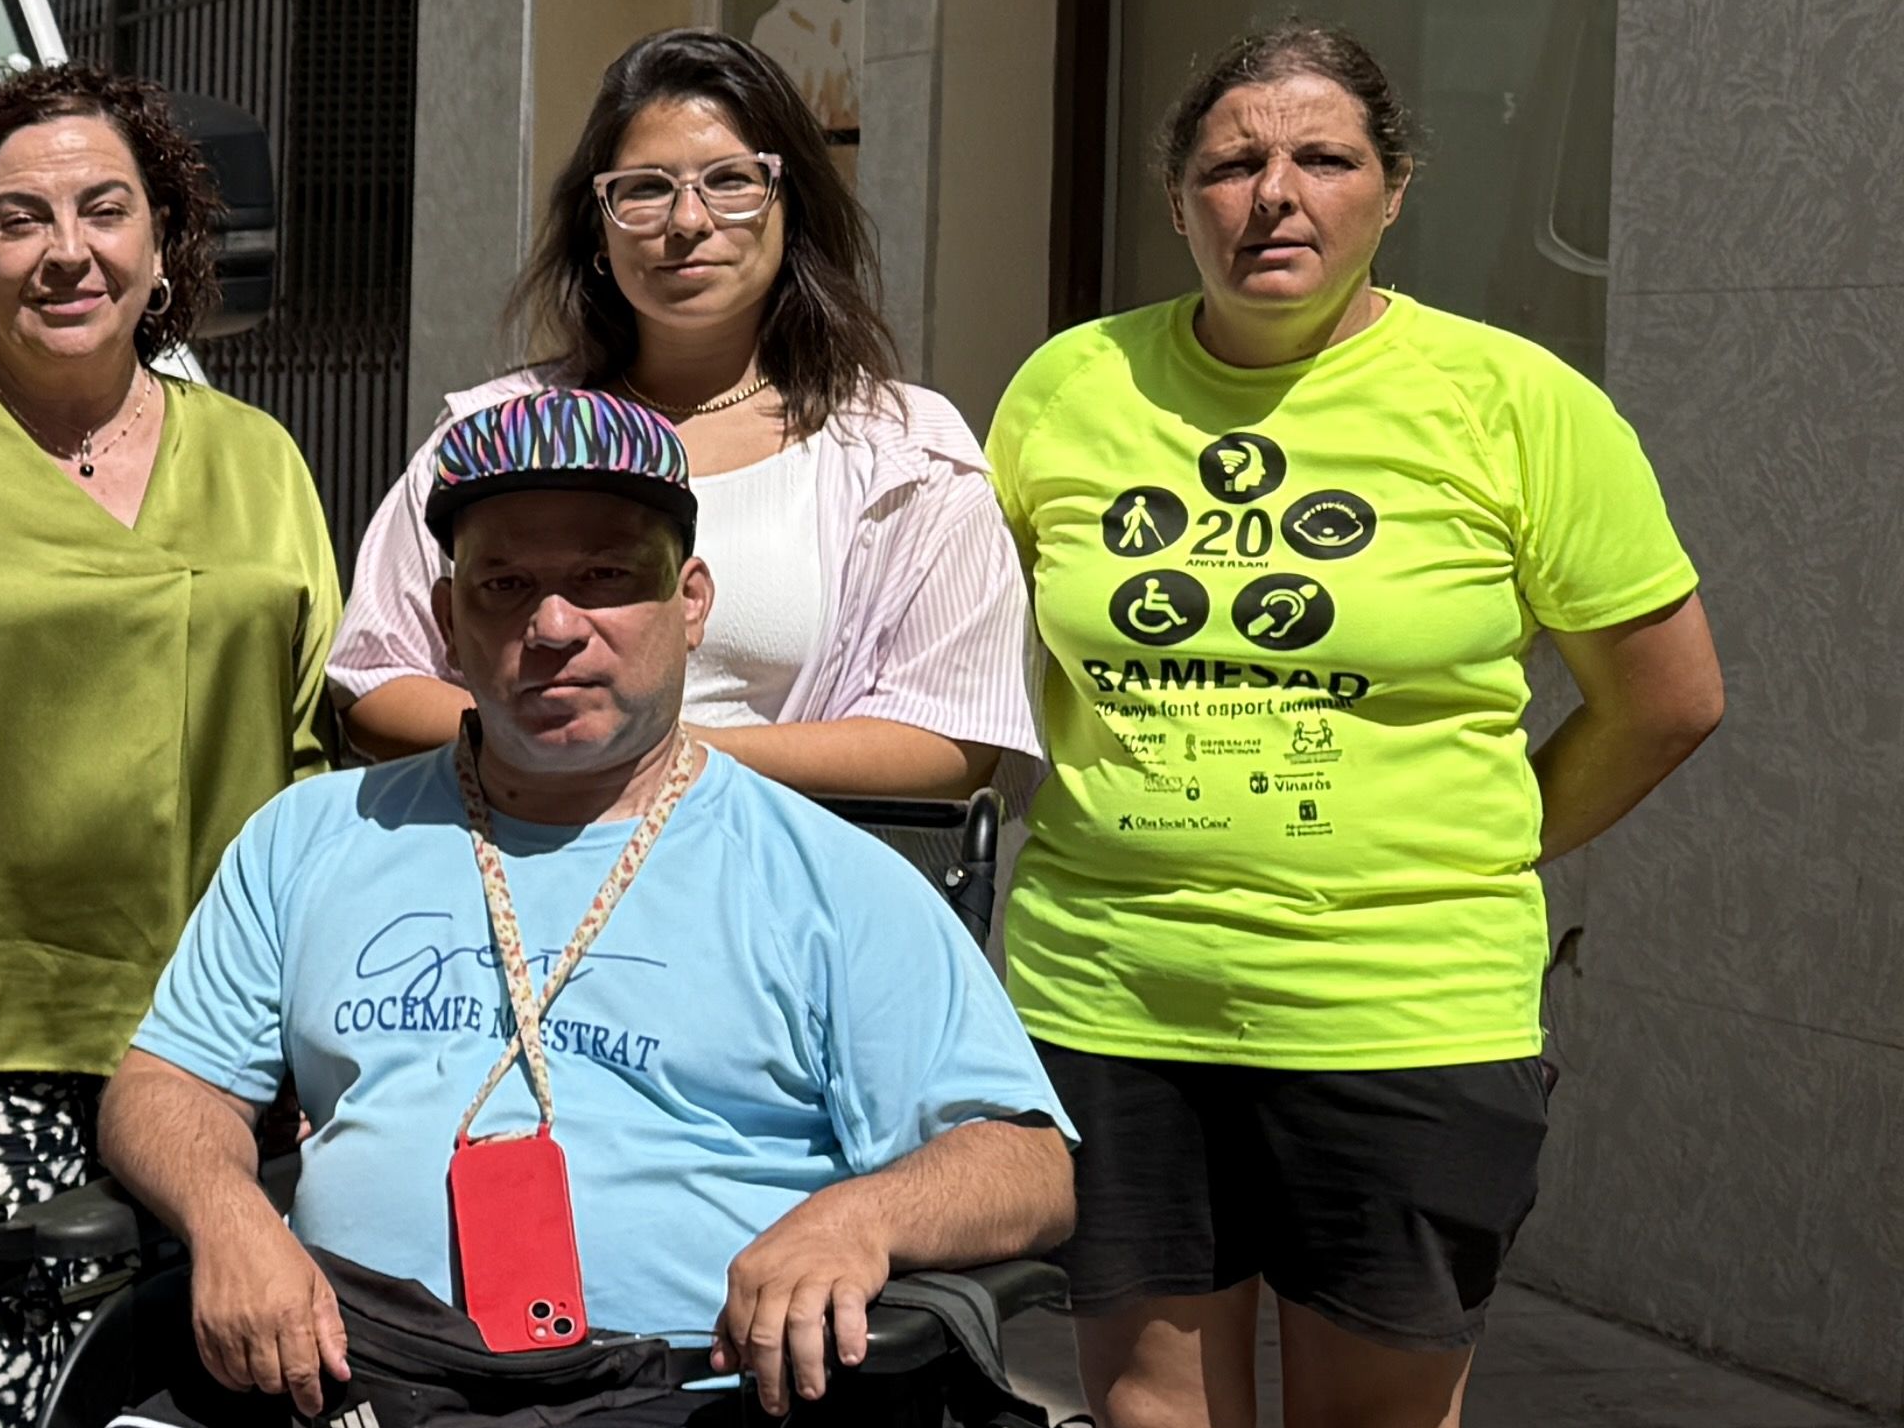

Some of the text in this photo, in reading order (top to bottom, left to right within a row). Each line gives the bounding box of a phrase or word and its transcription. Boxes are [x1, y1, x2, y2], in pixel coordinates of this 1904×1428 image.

[1189, 508, 1273, 558] 20
[334, 996, 660, 1073] COCEMFE MESTRAT
